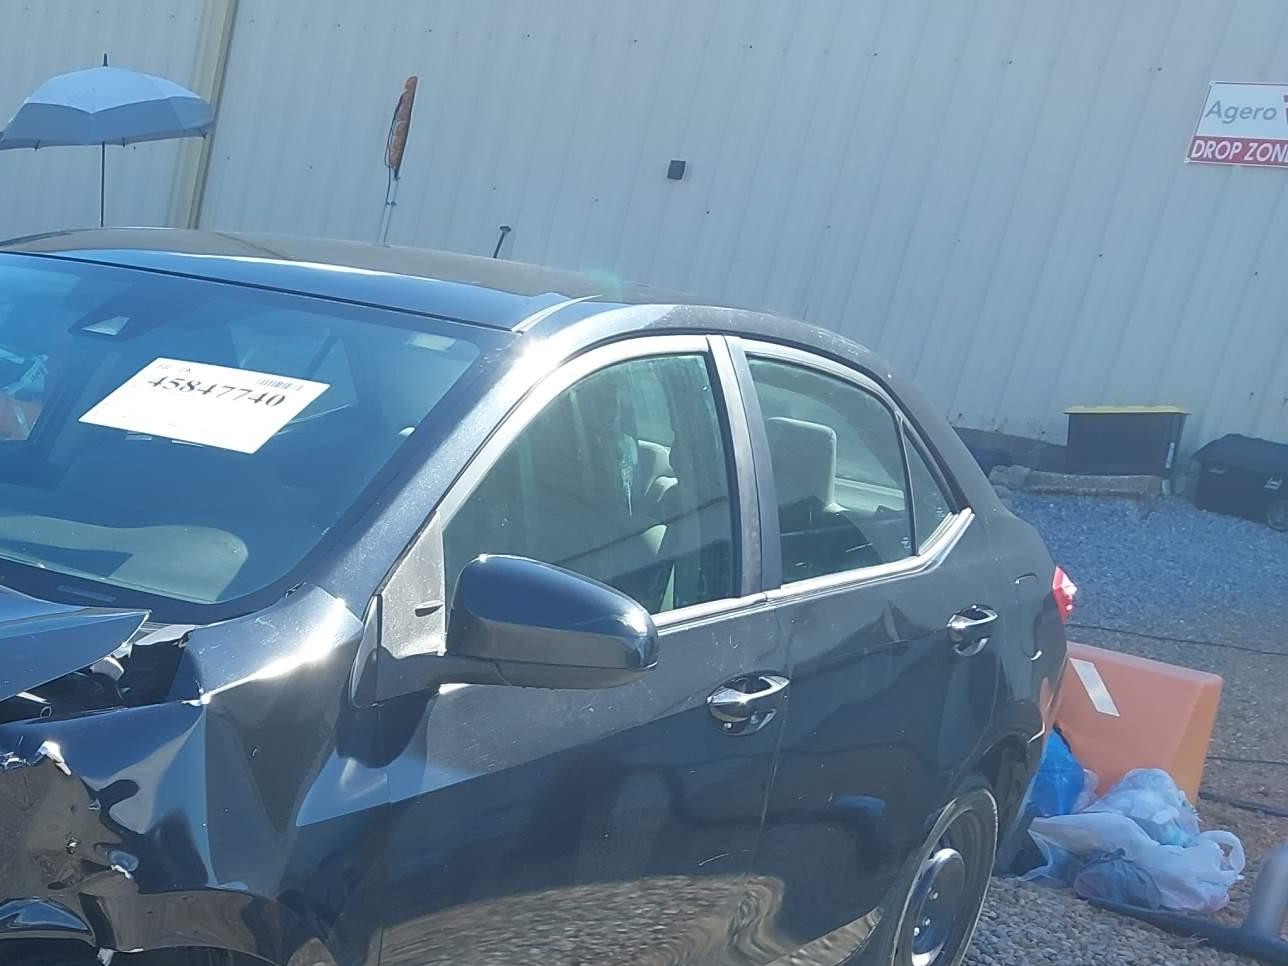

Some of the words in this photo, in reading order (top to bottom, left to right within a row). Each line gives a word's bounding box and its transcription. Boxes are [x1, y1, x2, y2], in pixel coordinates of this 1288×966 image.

[1205, 100, 1277, 124] Agero
[1191, 140, 1242, 160] DROP
[147, 375, 286, 408] 45847740
